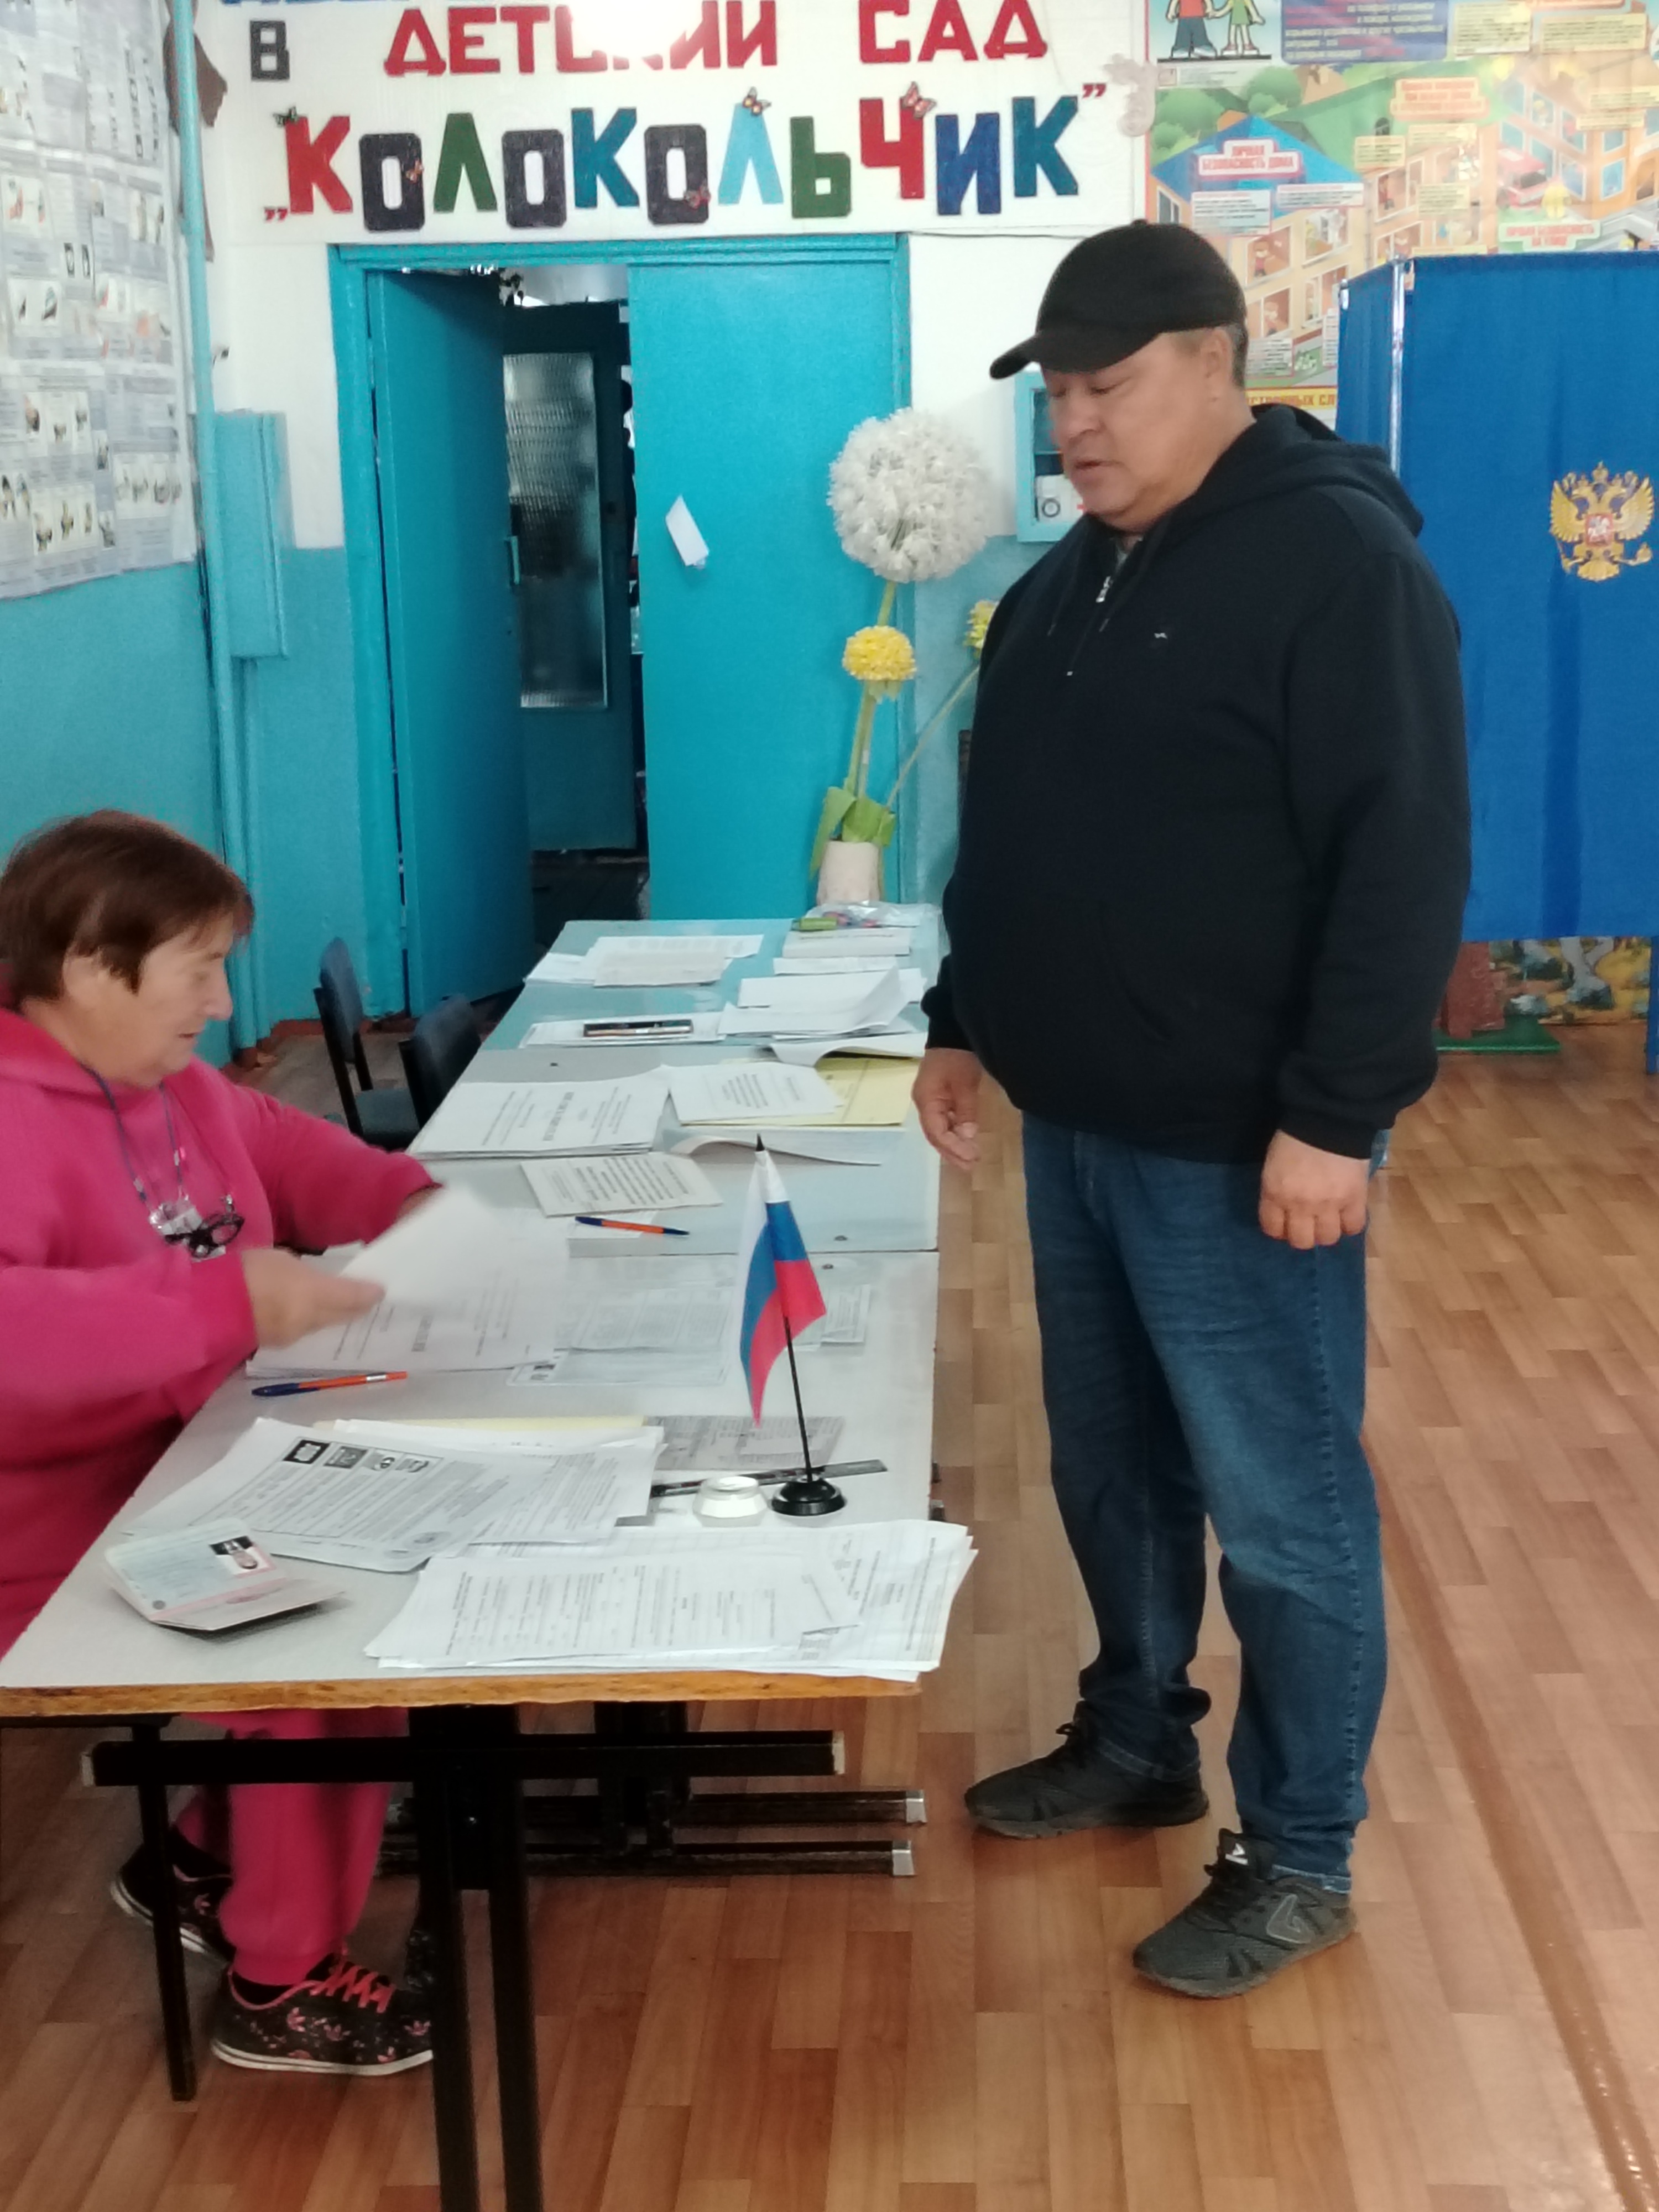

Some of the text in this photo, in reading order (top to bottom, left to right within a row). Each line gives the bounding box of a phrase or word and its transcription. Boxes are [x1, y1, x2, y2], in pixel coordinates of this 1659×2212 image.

[250, 0, 1047, 81] В ДЕТСИЙ САД
